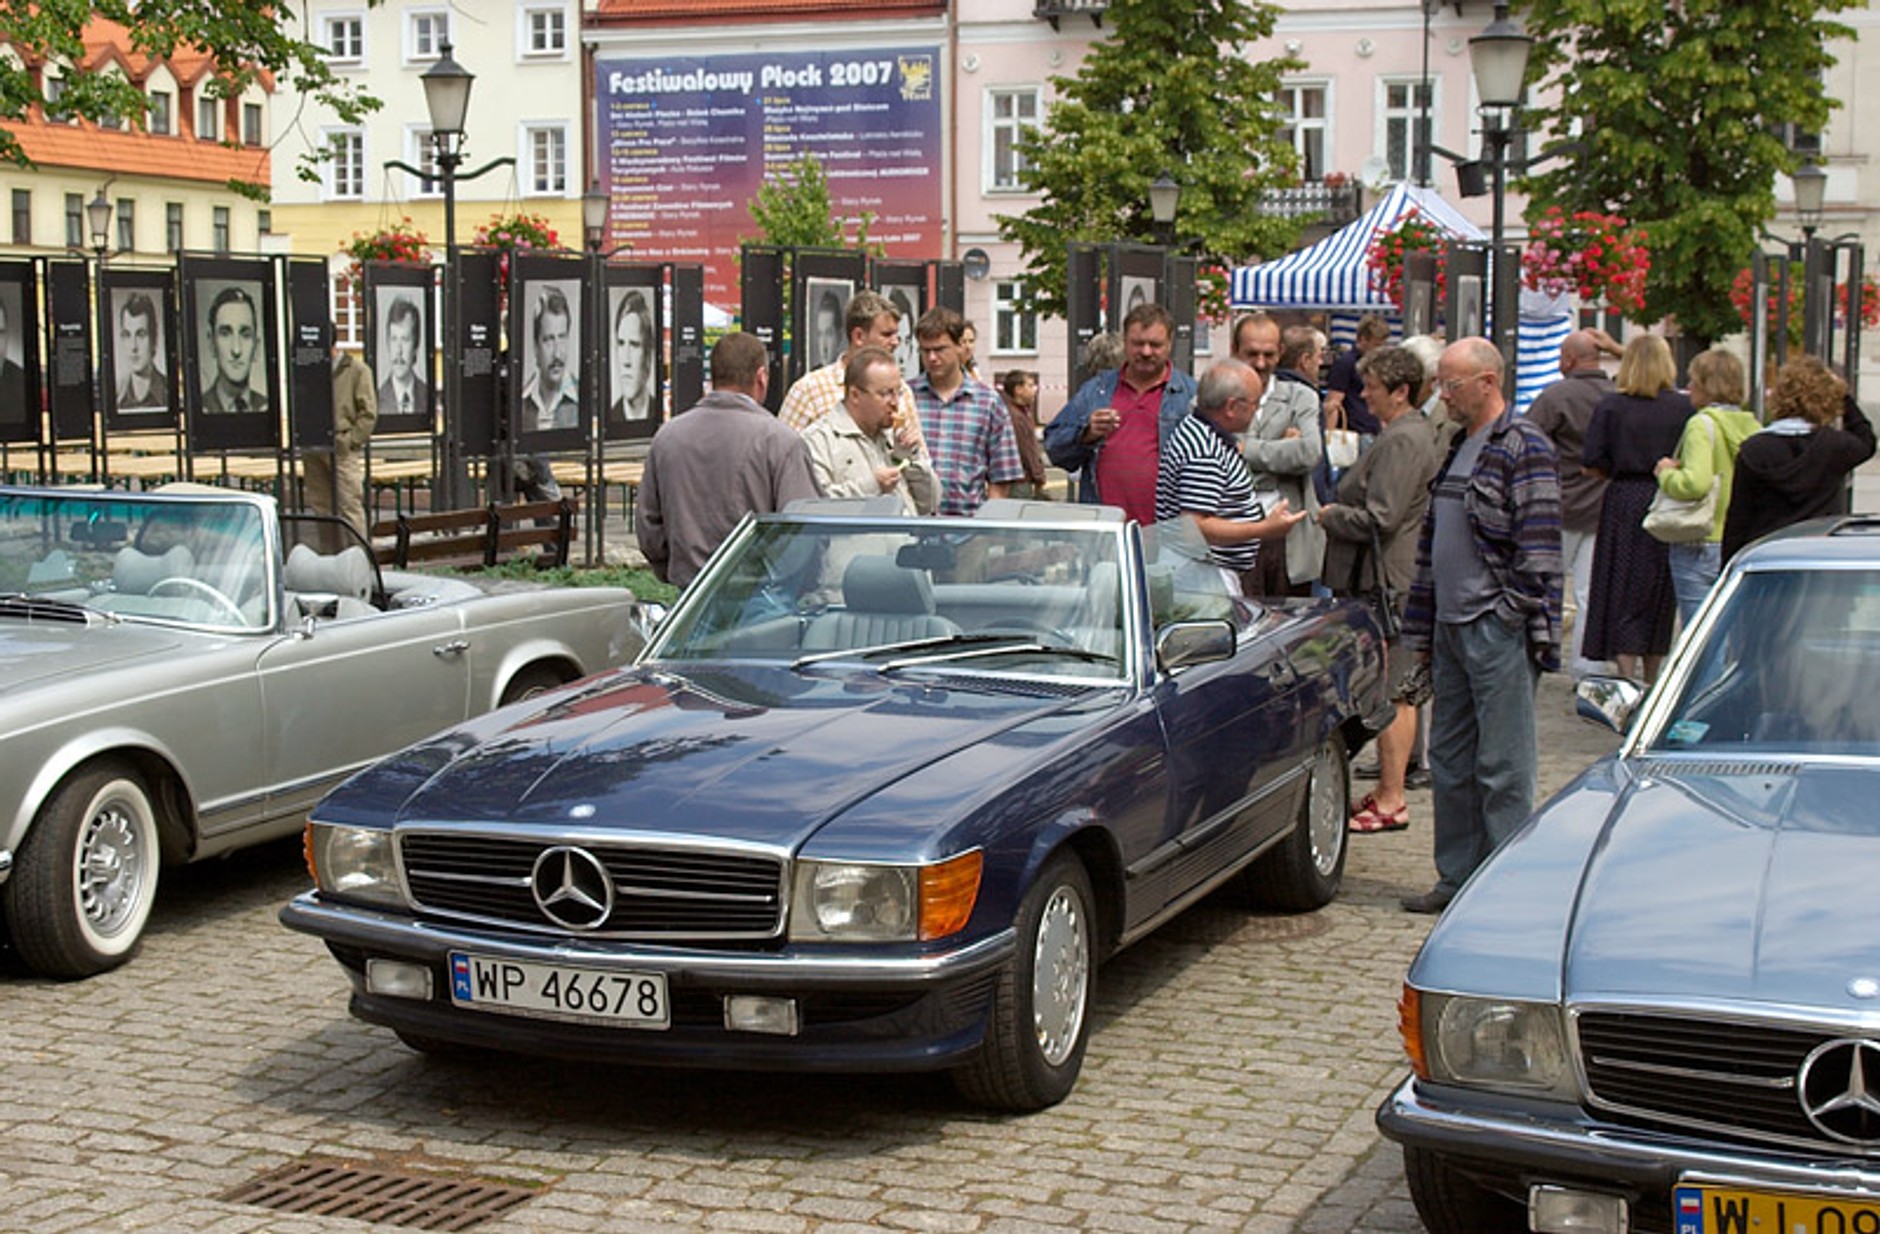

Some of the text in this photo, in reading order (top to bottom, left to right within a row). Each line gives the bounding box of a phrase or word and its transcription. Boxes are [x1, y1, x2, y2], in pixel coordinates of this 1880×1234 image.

[609, 68, 753, 95] Festiwalowy
[829, 60, 892, 86] 2007
[475, 961, 525, 1000] WP
[540, 970, 658, 1017] 46678
